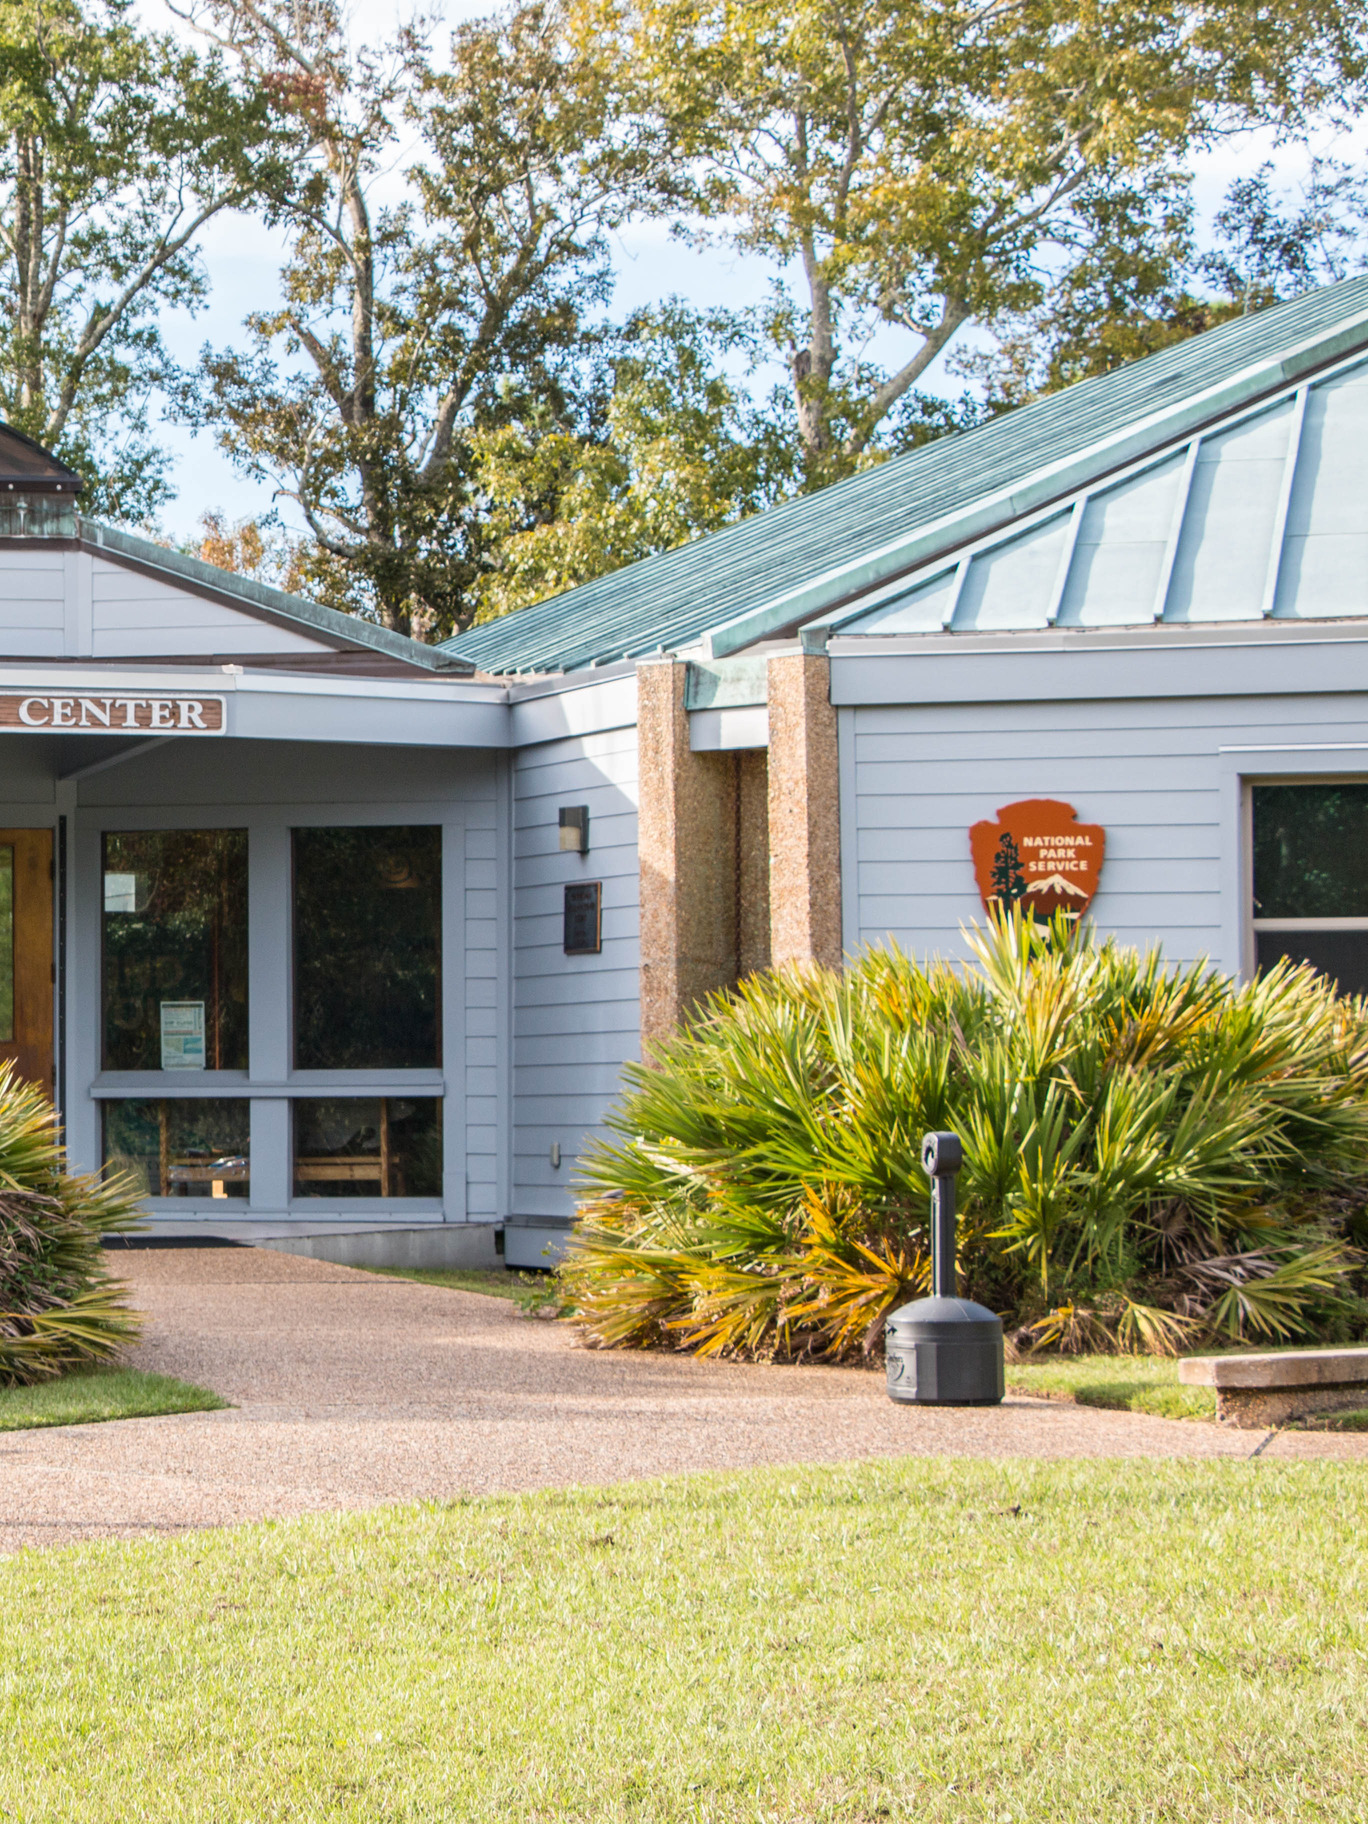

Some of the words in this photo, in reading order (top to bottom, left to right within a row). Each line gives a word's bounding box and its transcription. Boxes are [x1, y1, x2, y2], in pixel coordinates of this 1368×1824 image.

[18, 697, 208, 729] CENTER
[1022, 835, 1093, 847] NATIONAL
[1039, 848, 1076, 859] PARK
[1028, 860, 1088, 872] SERVICE
